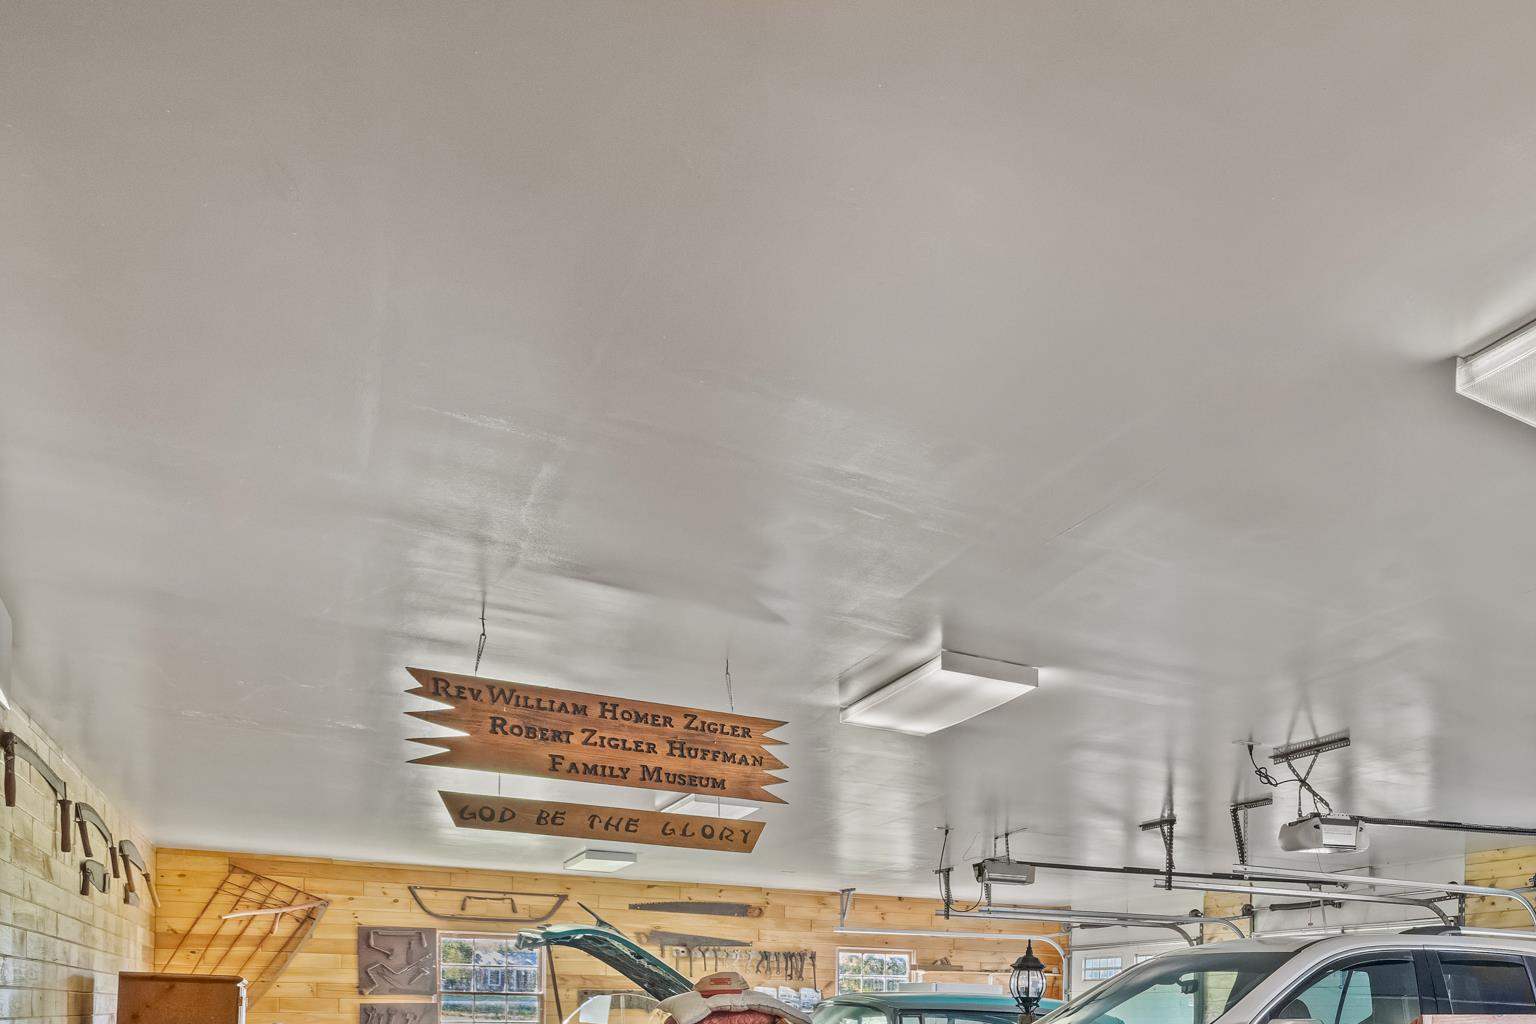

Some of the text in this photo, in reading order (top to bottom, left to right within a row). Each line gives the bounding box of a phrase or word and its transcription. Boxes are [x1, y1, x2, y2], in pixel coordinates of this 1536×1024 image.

[431, 676, 753, 739] REV. WILLIAM HOMER ZIGLER
[488, 715, 764, 768] ROBERT ZIGLER HUFFMAN
[548, 753, 727, 791] FAMILY MUSEUM
[458, 803, 756, 845] GOD BE THE GLORY
